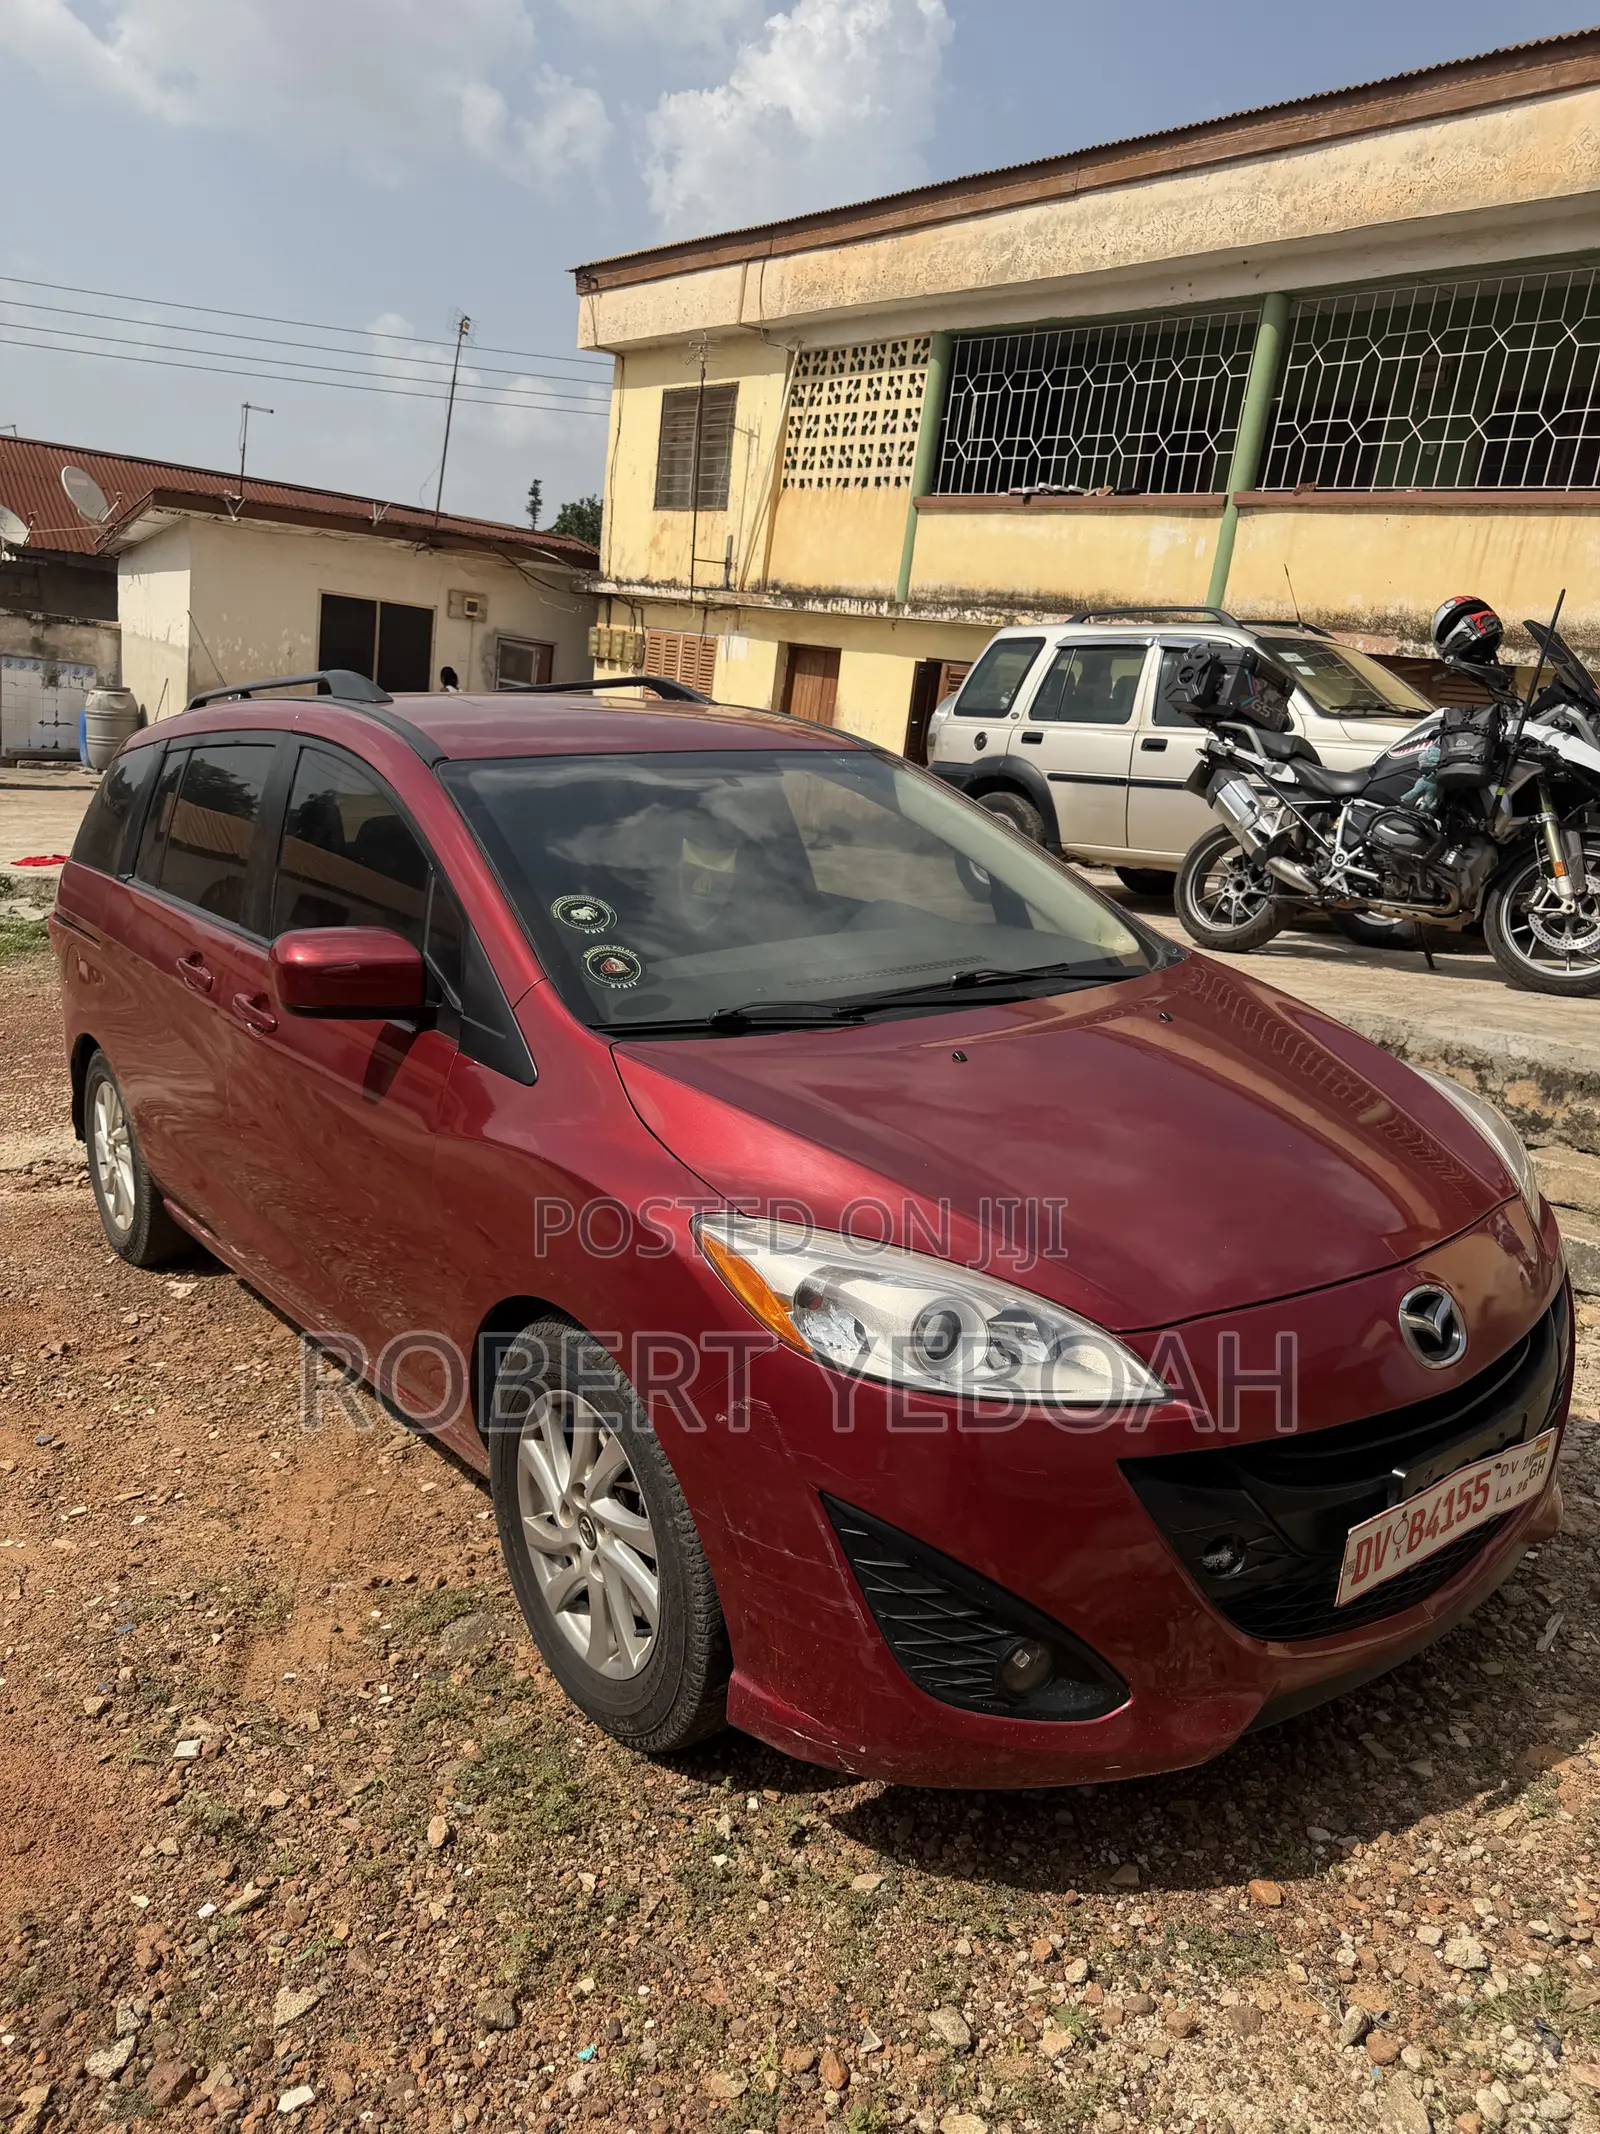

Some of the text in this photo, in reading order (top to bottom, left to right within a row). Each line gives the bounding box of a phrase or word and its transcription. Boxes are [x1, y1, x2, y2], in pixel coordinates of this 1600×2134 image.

[1251, 701, 1272, 719] GS
[1500, 1460, 1519, 1477] DV
[1529, 1457, 1547, 1480] GH
[1495, 1478, 1529, 1503] LA 26
[1350, 1469, 1492, 1586] DV B4155
